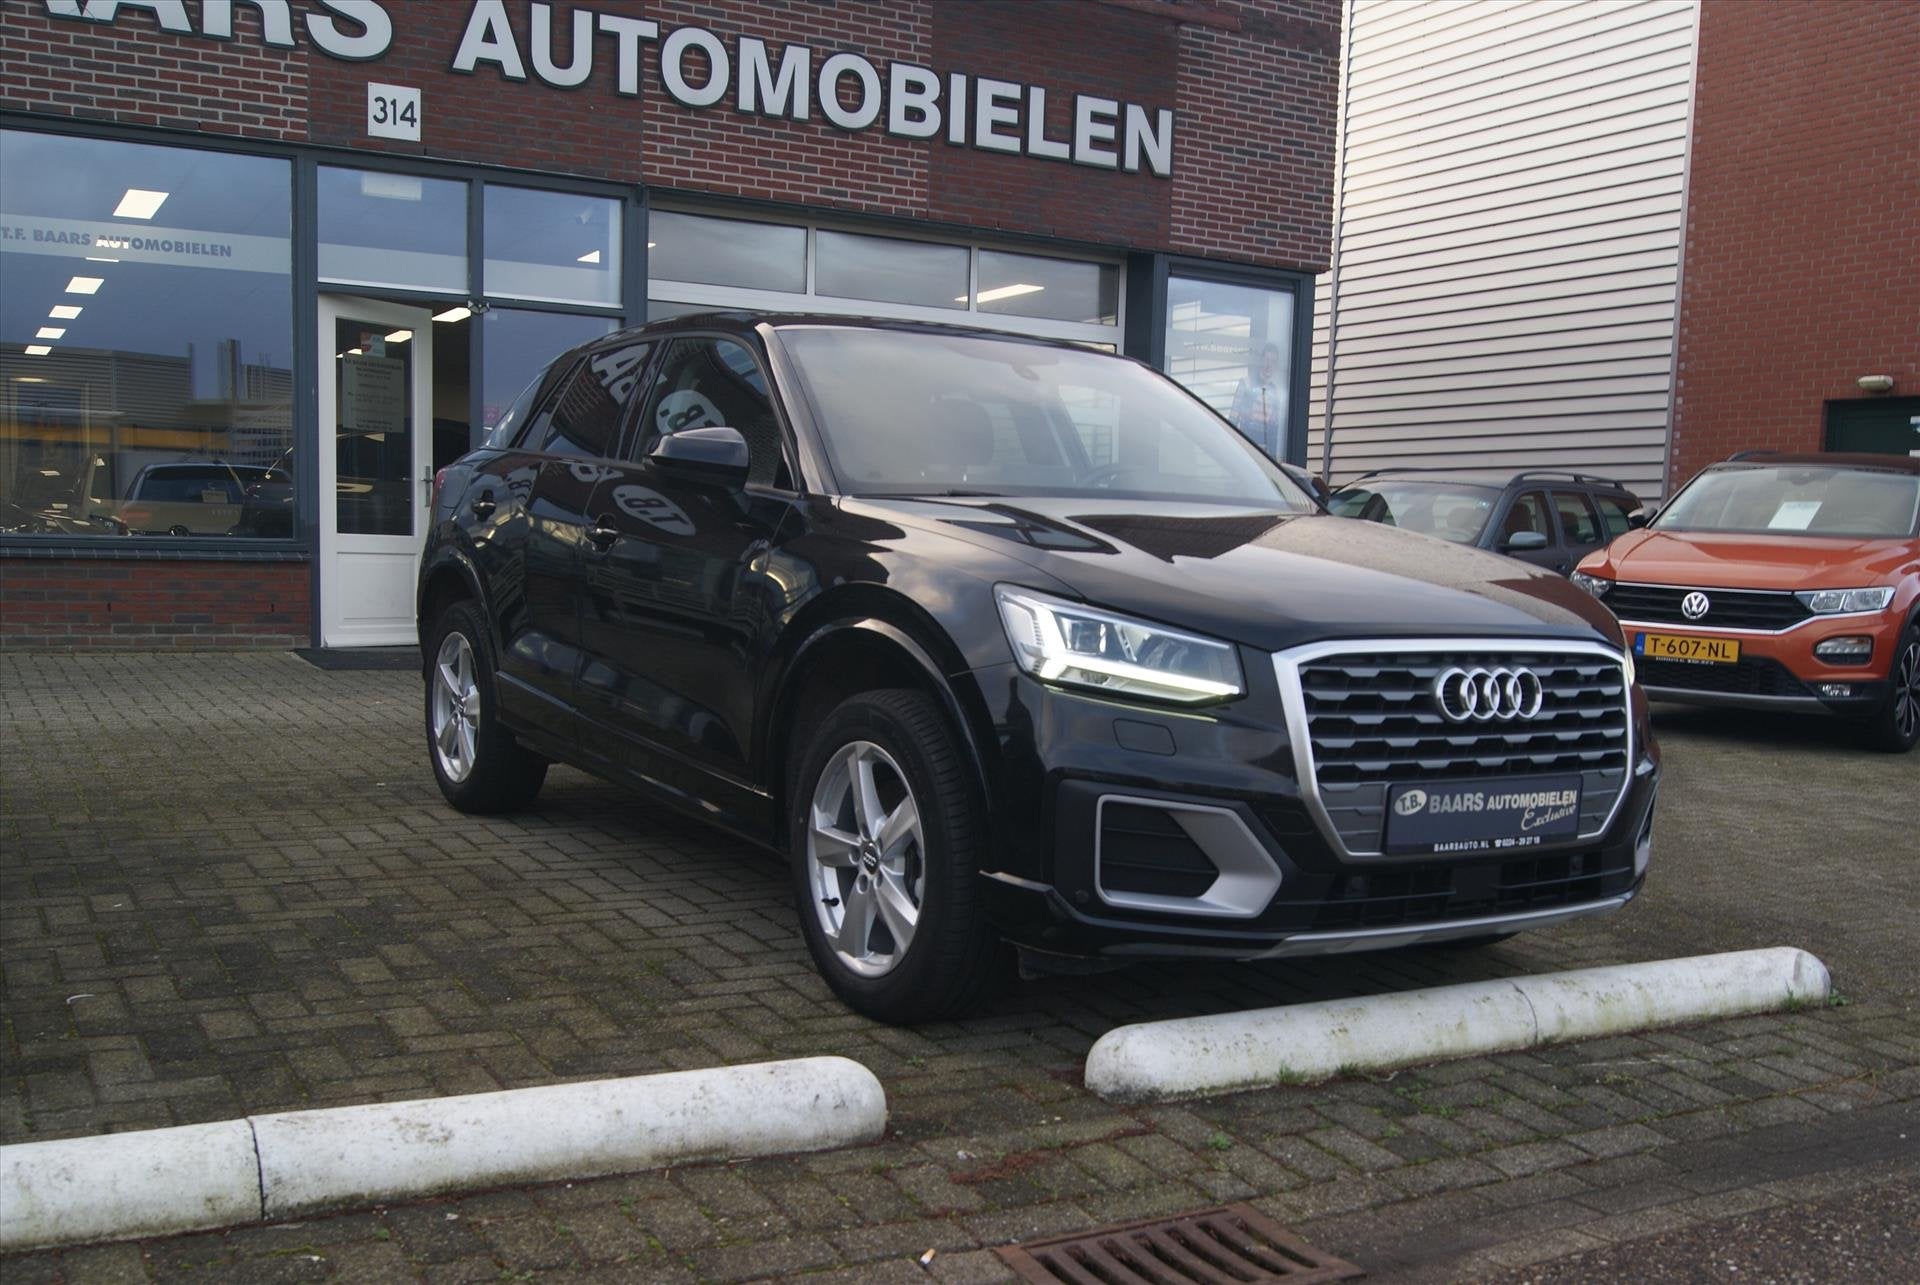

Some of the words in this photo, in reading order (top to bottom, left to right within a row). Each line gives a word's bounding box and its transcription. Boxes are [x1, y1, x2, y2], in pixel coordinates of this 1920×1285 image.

[450, 0, 1173, 178] AUTOMOBIELEN
[373, 96, 417, 127] 314
[33, 229, 91, 245] BAARS
[96, 235, 232, 257] AUTOMOBIELEN
[1651, 638, 1730, 659] T-607-NL
[1400, 794, 1422, 812] T.B.
[1429, 792, 1484, 814] BAARS
[1486, 790, 1577, 811] AUTOMOBIELEN
[1434, 840, 1489, 852] BAARSAUTO.NL
